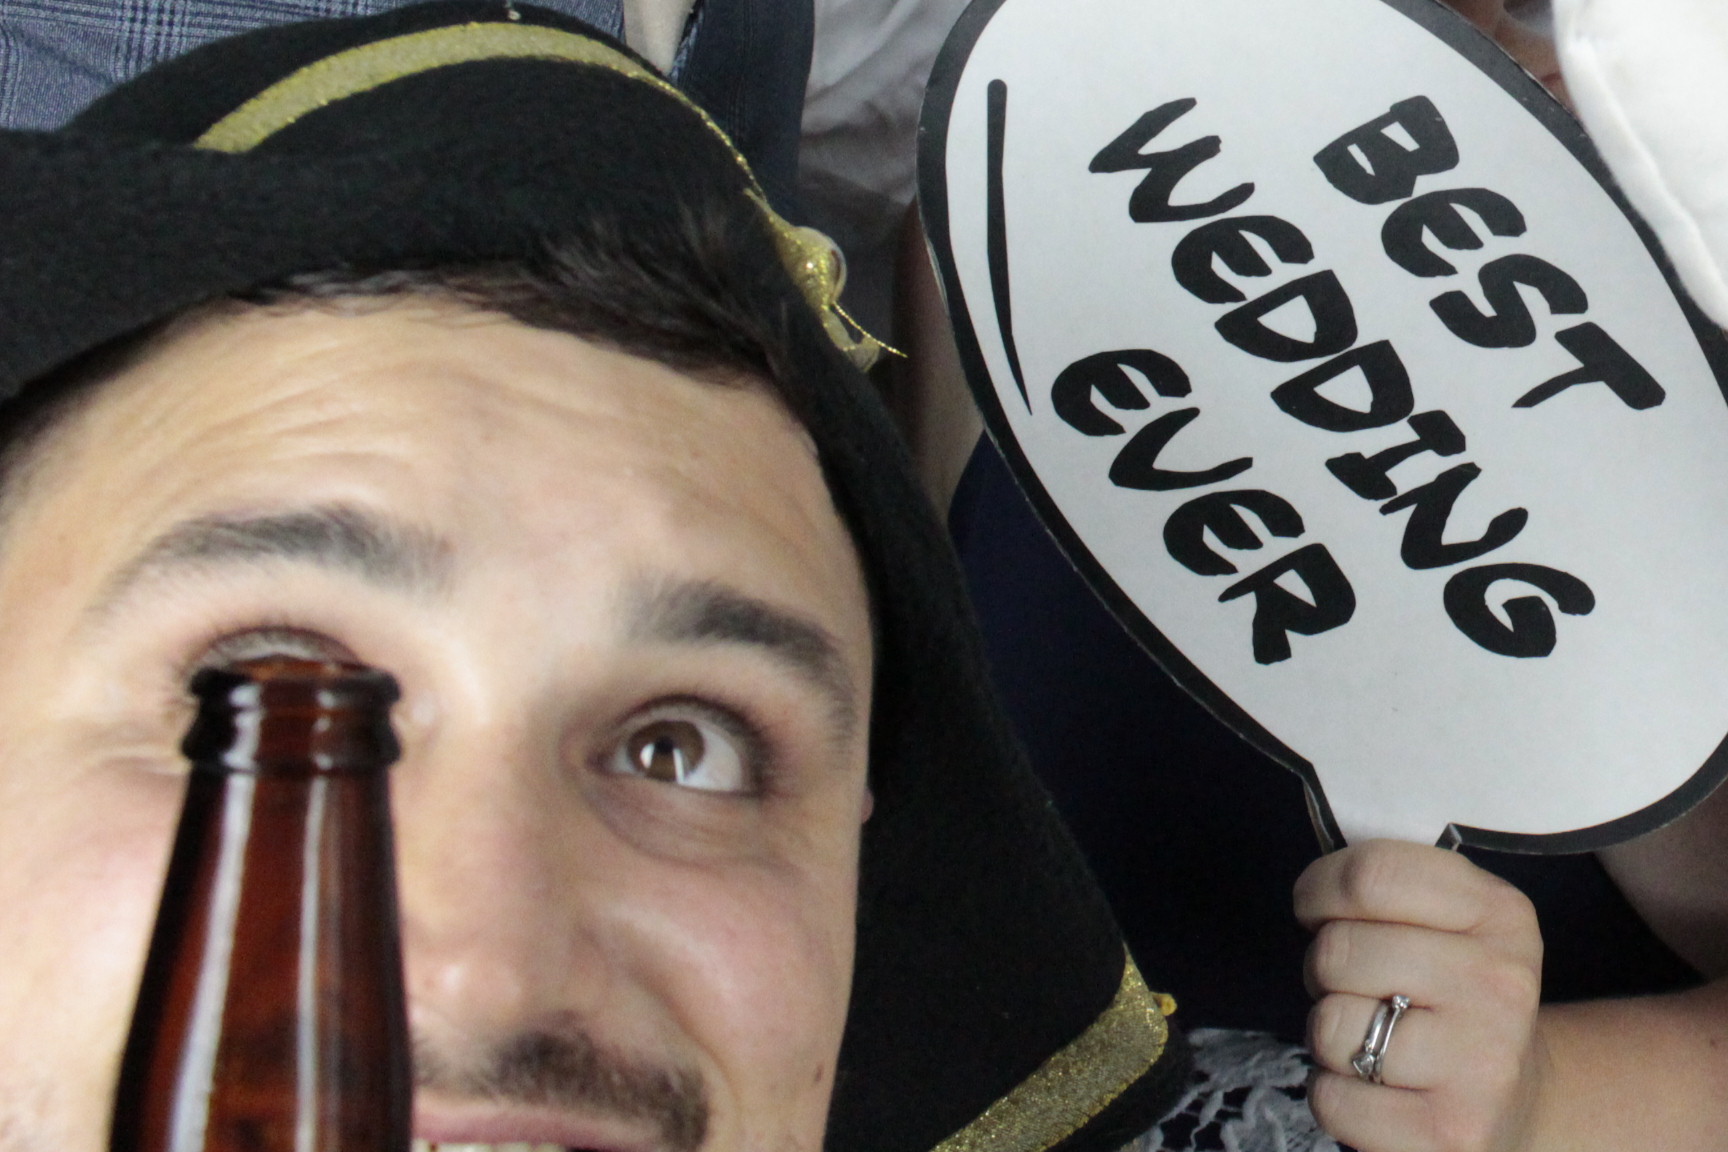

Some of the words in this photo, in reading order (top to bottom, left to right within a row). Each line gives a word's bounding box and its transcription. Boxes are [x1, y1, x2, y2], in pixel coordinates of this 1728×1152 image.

[1088, 96, 1596, 658] WEDDING
[1313, 94, 1667, 411] BEST
[1050, 348, 1357, 665] EVER
